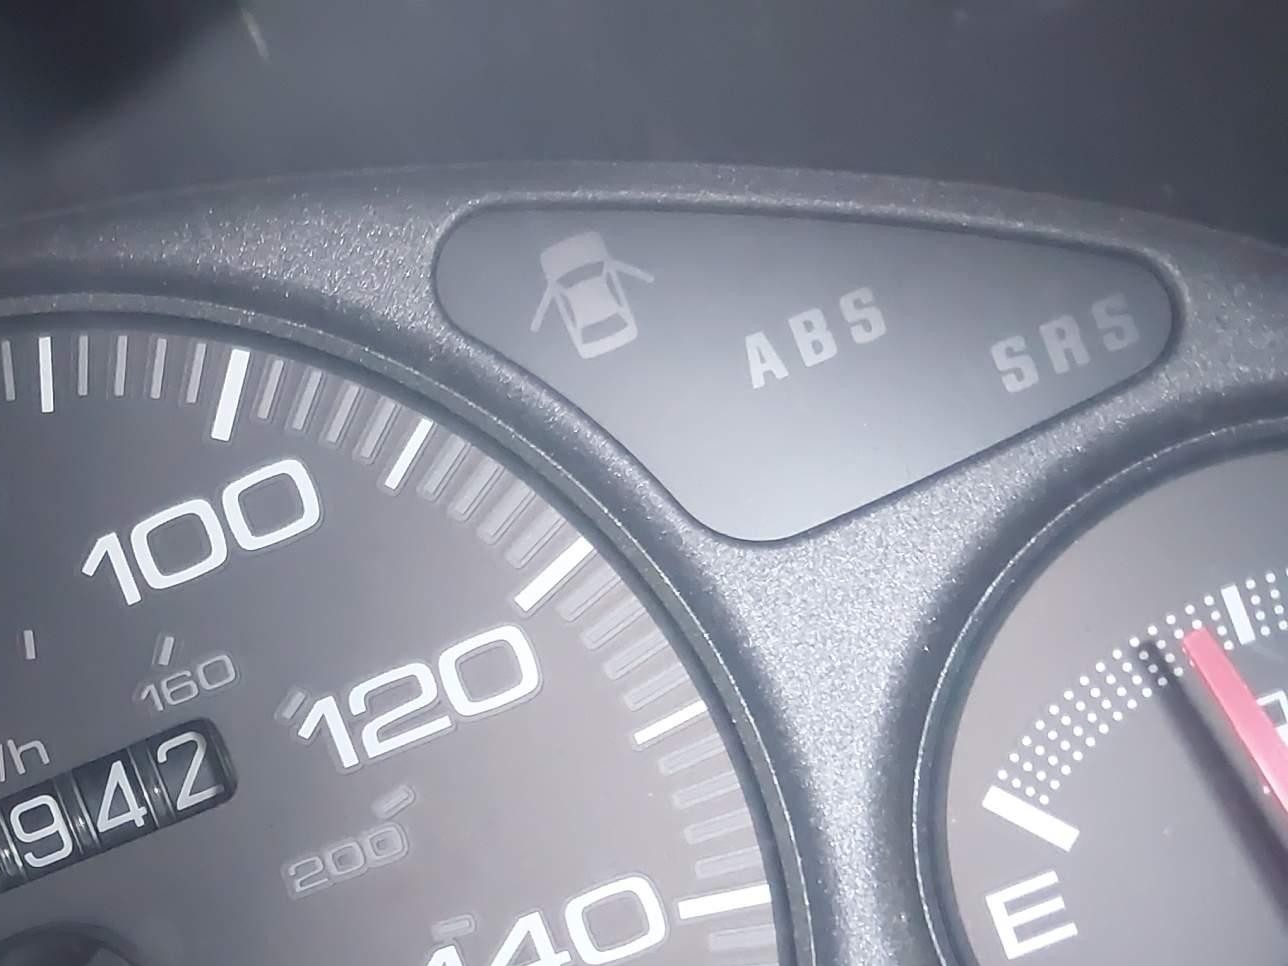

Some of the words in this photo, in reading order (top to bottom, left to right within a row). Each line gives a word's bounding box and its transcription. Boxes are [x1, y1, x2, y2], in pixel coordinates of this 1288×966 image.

[744, 287, 887, 388] ABS
[988, 293, 1140, 392] SRS
[81, 458, 321, 605] 100
[139, 653, 237, 712] 160
[297, 624, 539, 768] 120
[287, 825, 406, 894] 200
[985, 870, 1078, 960] E
